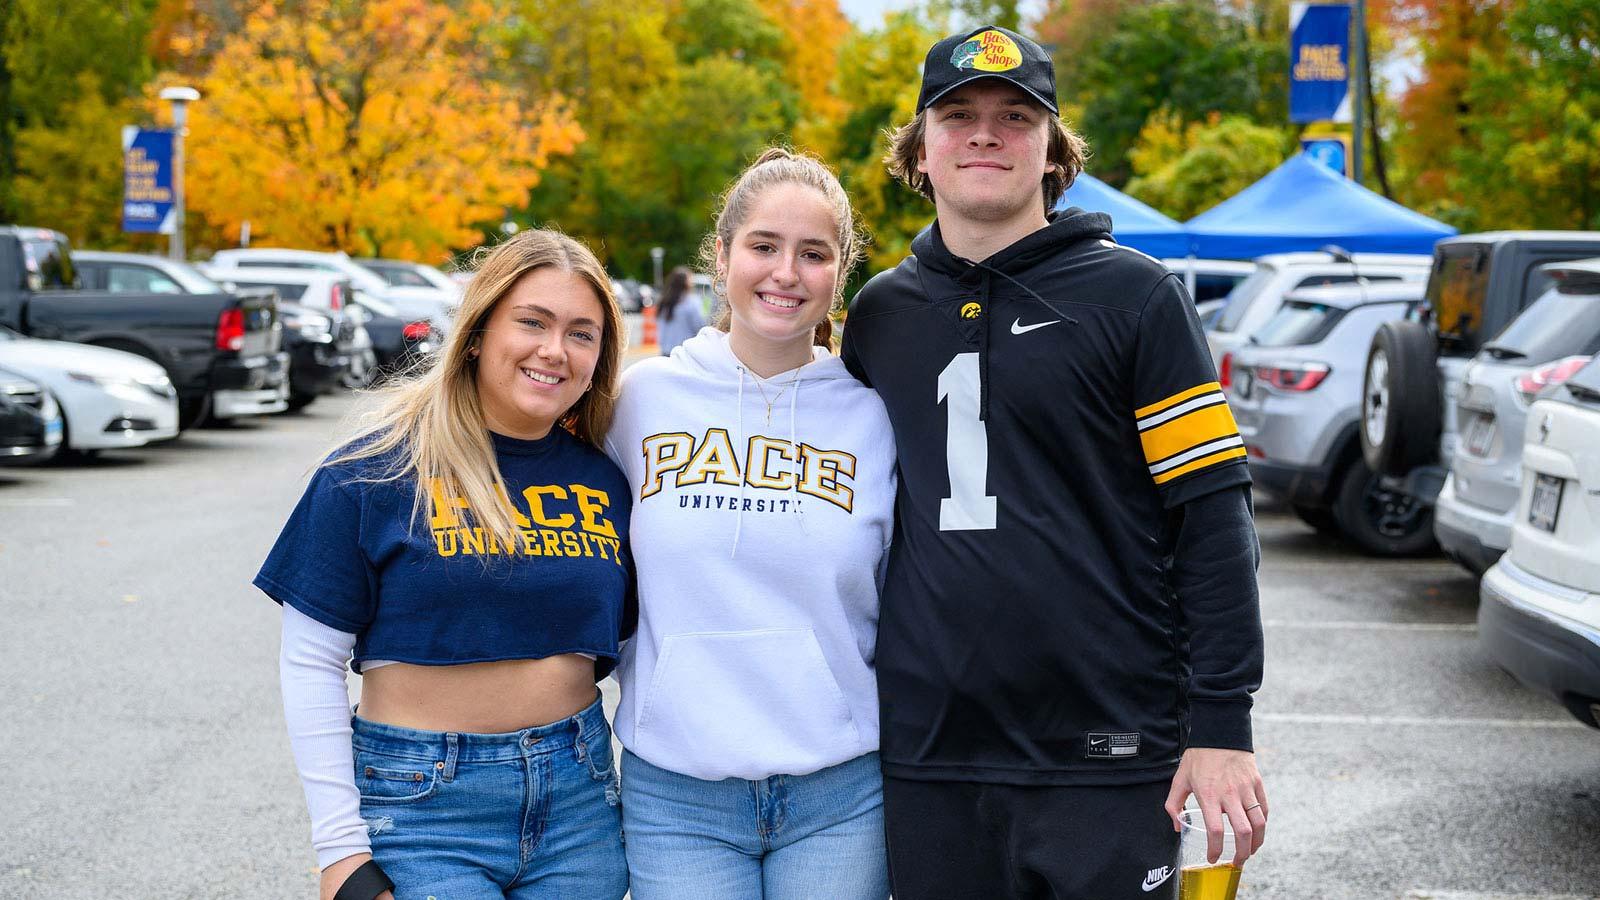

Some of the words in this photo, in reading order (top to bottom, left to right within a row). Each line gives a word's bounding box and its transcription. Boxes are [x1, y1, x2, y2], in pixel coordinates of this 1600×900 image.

[983, 31, 1011, 46] Bass
[984, 43, 1005, 55] Pro
[983, 54, 1018, 67] Shops
[937, 352, 997, 531] 1
[640, 428, 857, 514] PACE
[1147, 865, 1168, 883] NIKE
